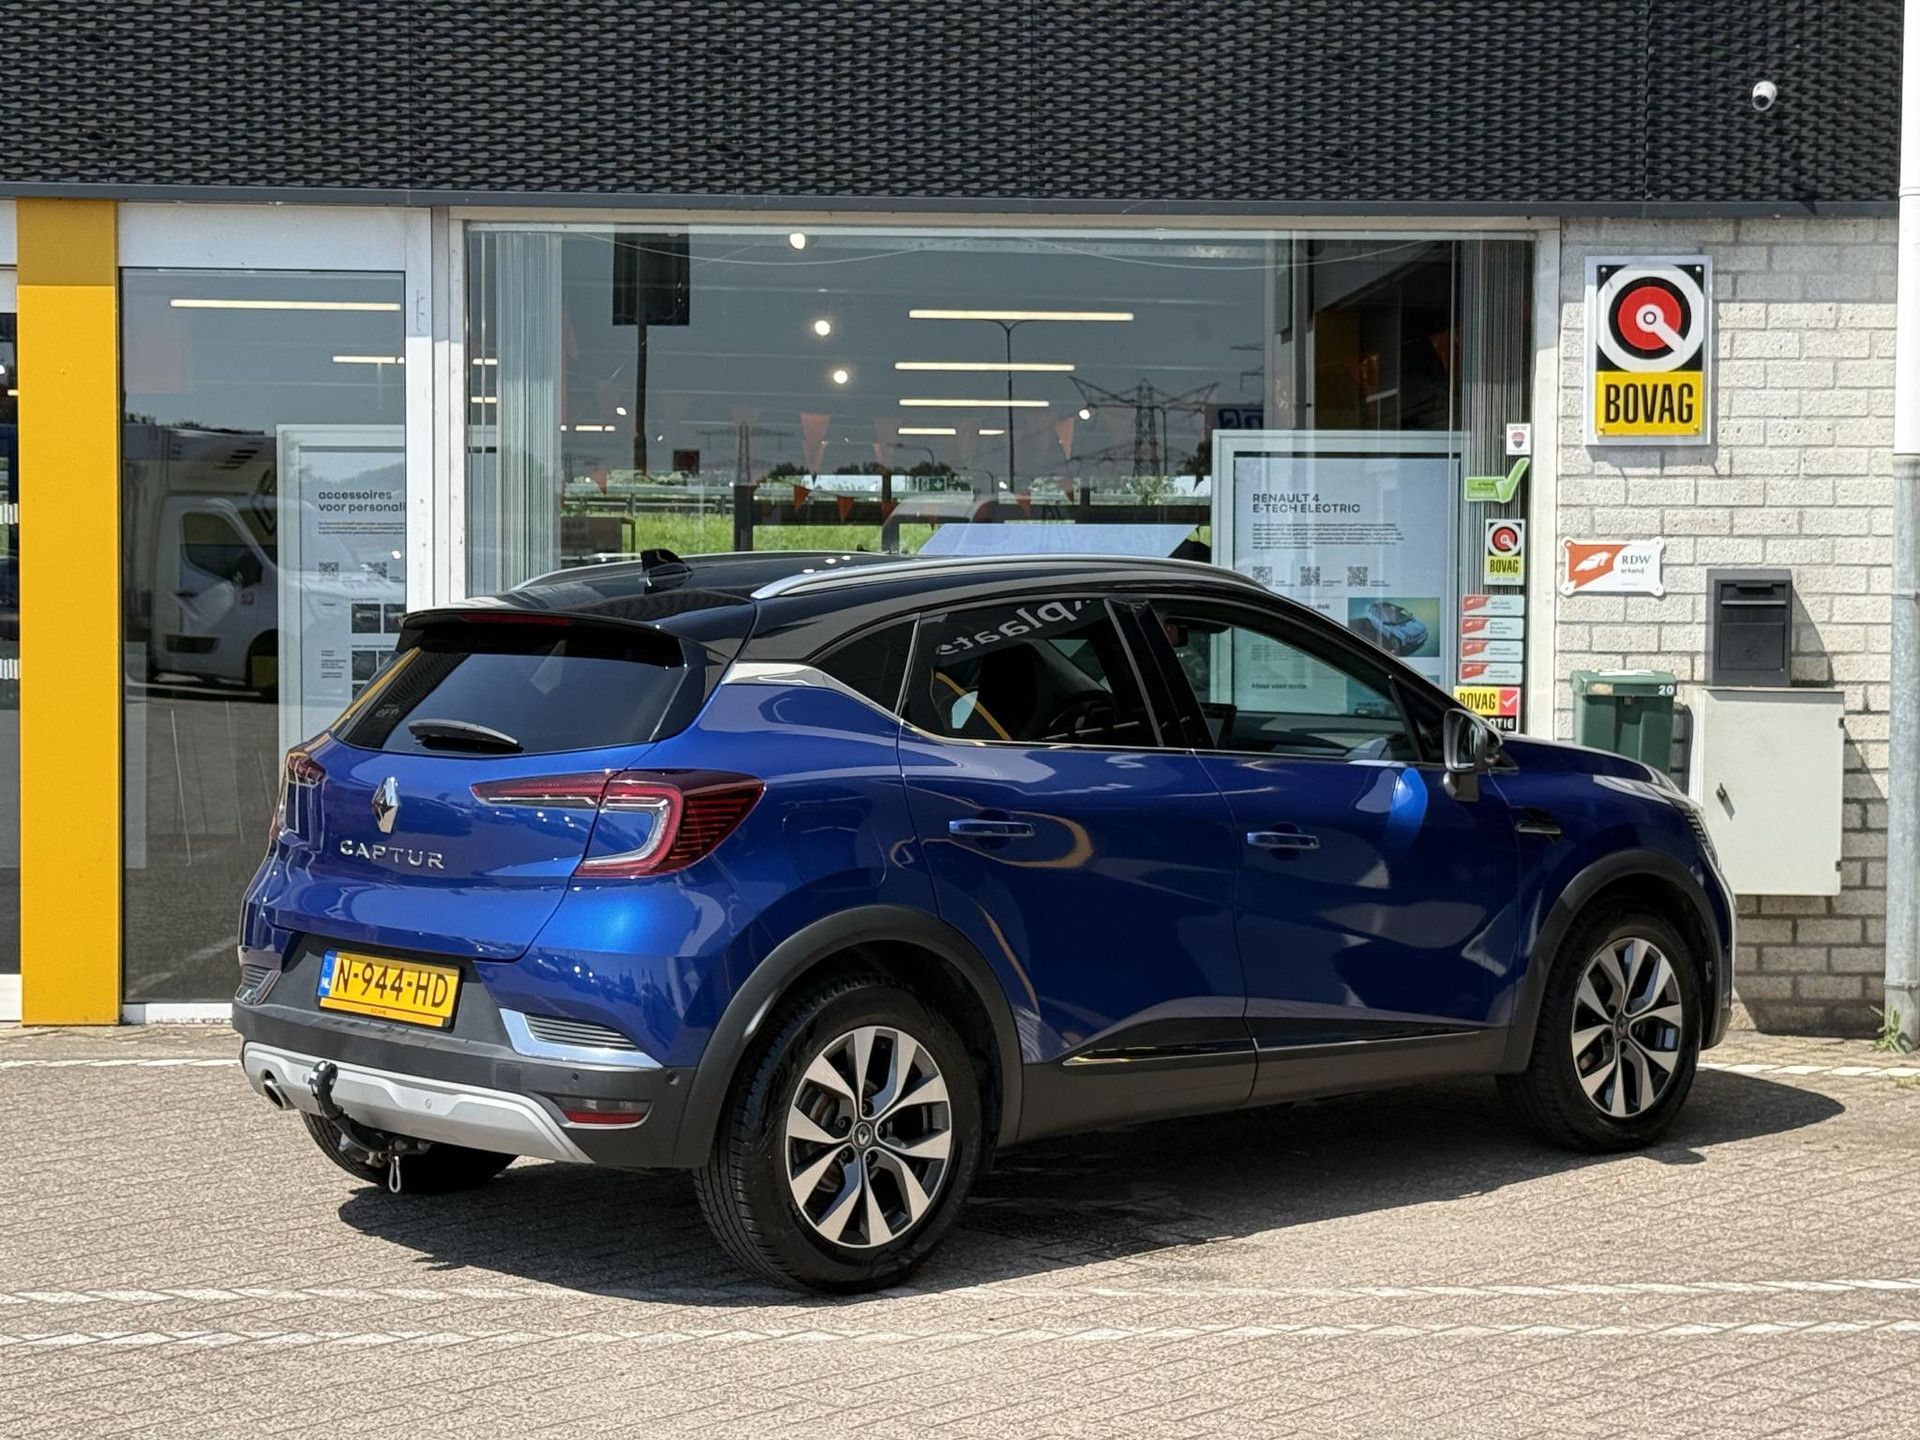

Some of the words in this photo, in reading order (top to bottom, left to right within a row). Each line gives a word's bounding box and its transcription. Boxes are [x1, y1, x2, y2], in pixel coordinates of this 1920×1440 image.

[1604, 383, 1694, 424] BOVAG
[318, 489, 392, 500] accessoires
[1252, 493, 1310, 503] RENAULT
[1312, 493, 1320, 503] 4
[318, 503, 347, 512] voor
[1252, 503, 1298, 513] E-TECH
[1300, 503, 1361, 513] ELECTRIC
[1621, 554, 1651, 565] RDW
[1489, 559, 1519, 574] BOVAG
[1658, 684, 1674, 695] 20
[1459, 692, 1496, 710] BOVAG
[340, 840, 444, 869] CAPTUR
[335, 959, 449, 1008] N-944-HD
